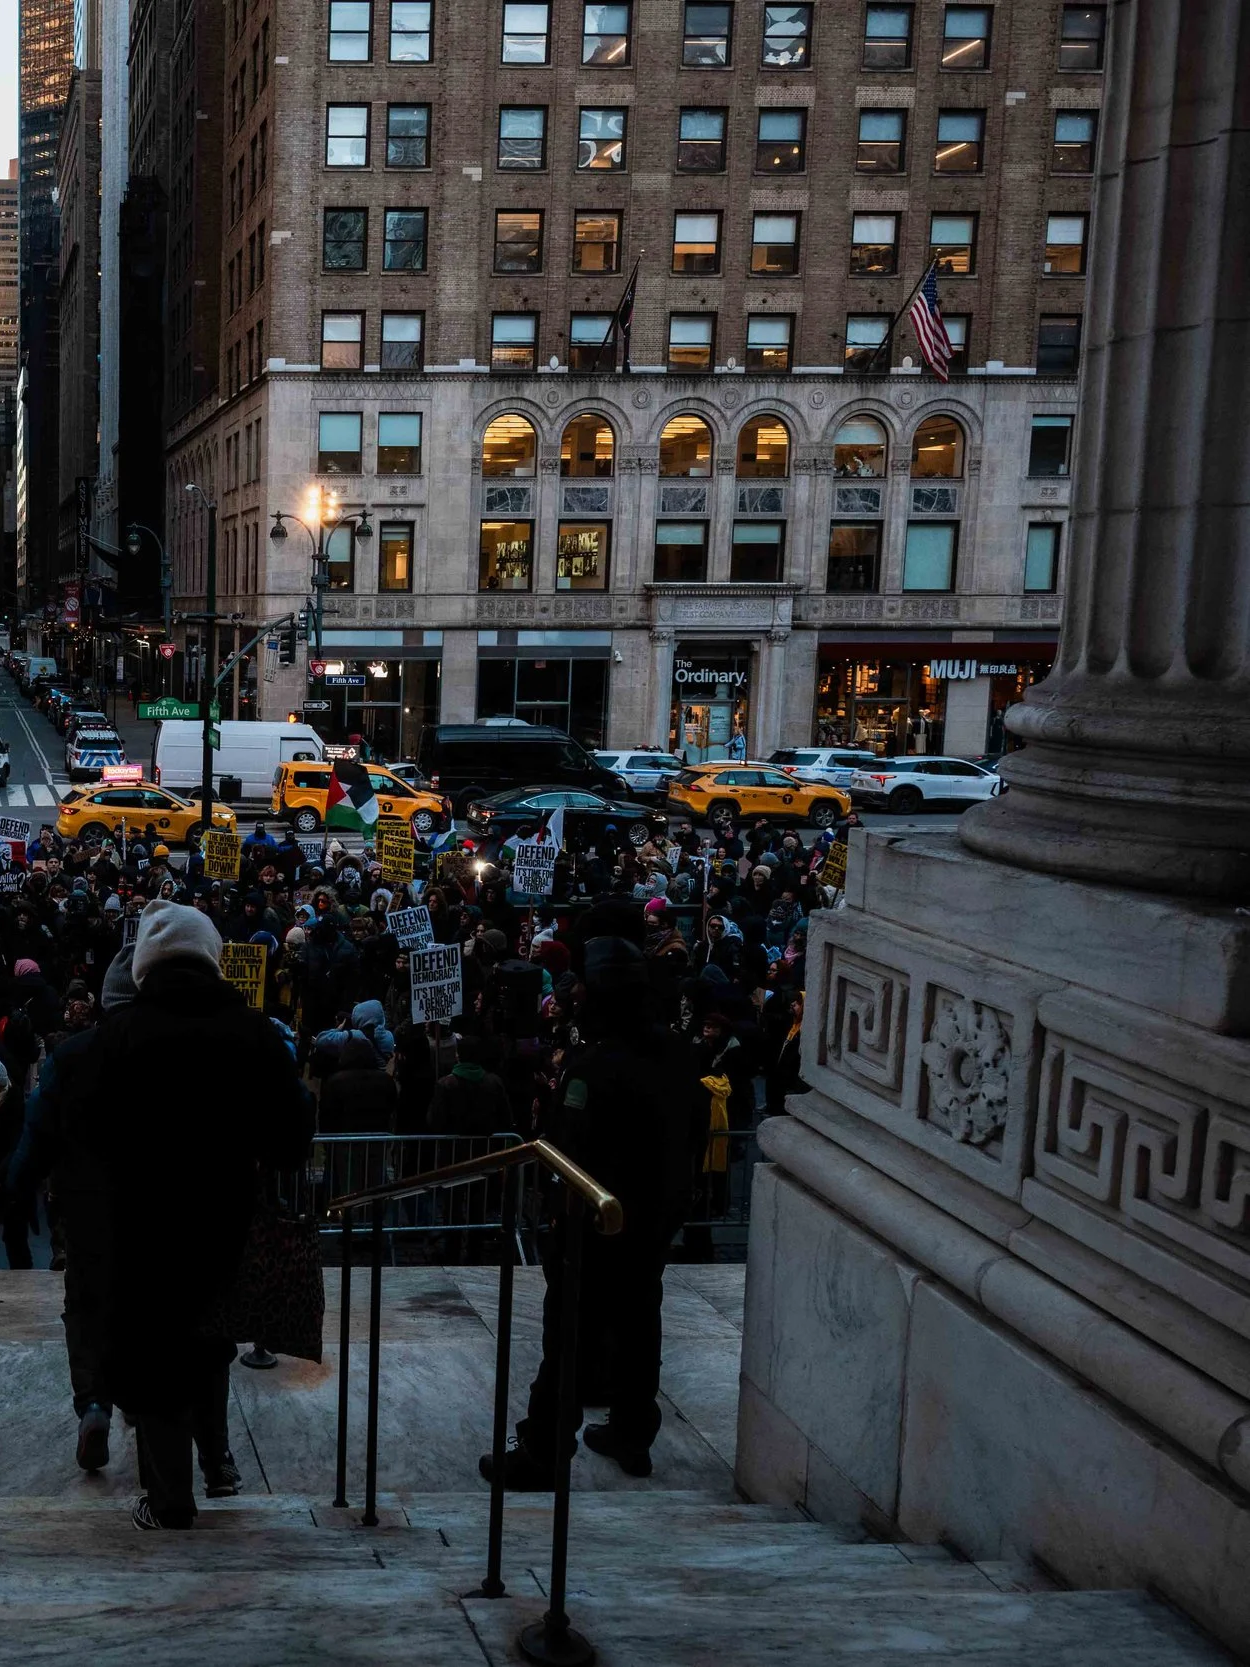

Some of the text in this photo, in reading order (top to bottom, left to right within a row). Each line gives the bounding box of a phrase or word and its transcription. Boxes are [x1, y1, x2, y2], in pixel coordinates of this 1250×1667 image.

[675, 660, 692, 668] The
[930, 659, 977, 679] MUJI
[979, 665, 1017, 674] 無印良品
[675, 669, 747, 687] Ordinary.
[147, 706, 190, 716] Fifth Ave
[0, 818, 30, 834] DEFEND
[220, 833, 238, 842] WHOLE
[208, 844, 238, 856] IS GUILTY
[384, 845, 412, 860] DISEASE
[518, 845, 556, 860] DEFEND
[208, 862, 235, 874] DOWN!
[516, 858, 555, 870] DEMOCRACY:
[528, 868, 543, 878] TIME
[390, 907, 428, 930] DEFEND
[395, 923, 430, 938] EMOCRACY:
[233, 945, 262, 957] WHOLE
[412, 947, 459, 973] DEFEND
[226, 964, 261, 979] GUILTY
[412, 966, 460, 985] DEMOCRACY:
[413, 981, 461, 1001] IT'S TIME FOR
[419, 992, 457, 1011] A GENERAL
[424, 1004, 453, 1020] STRIKE!
